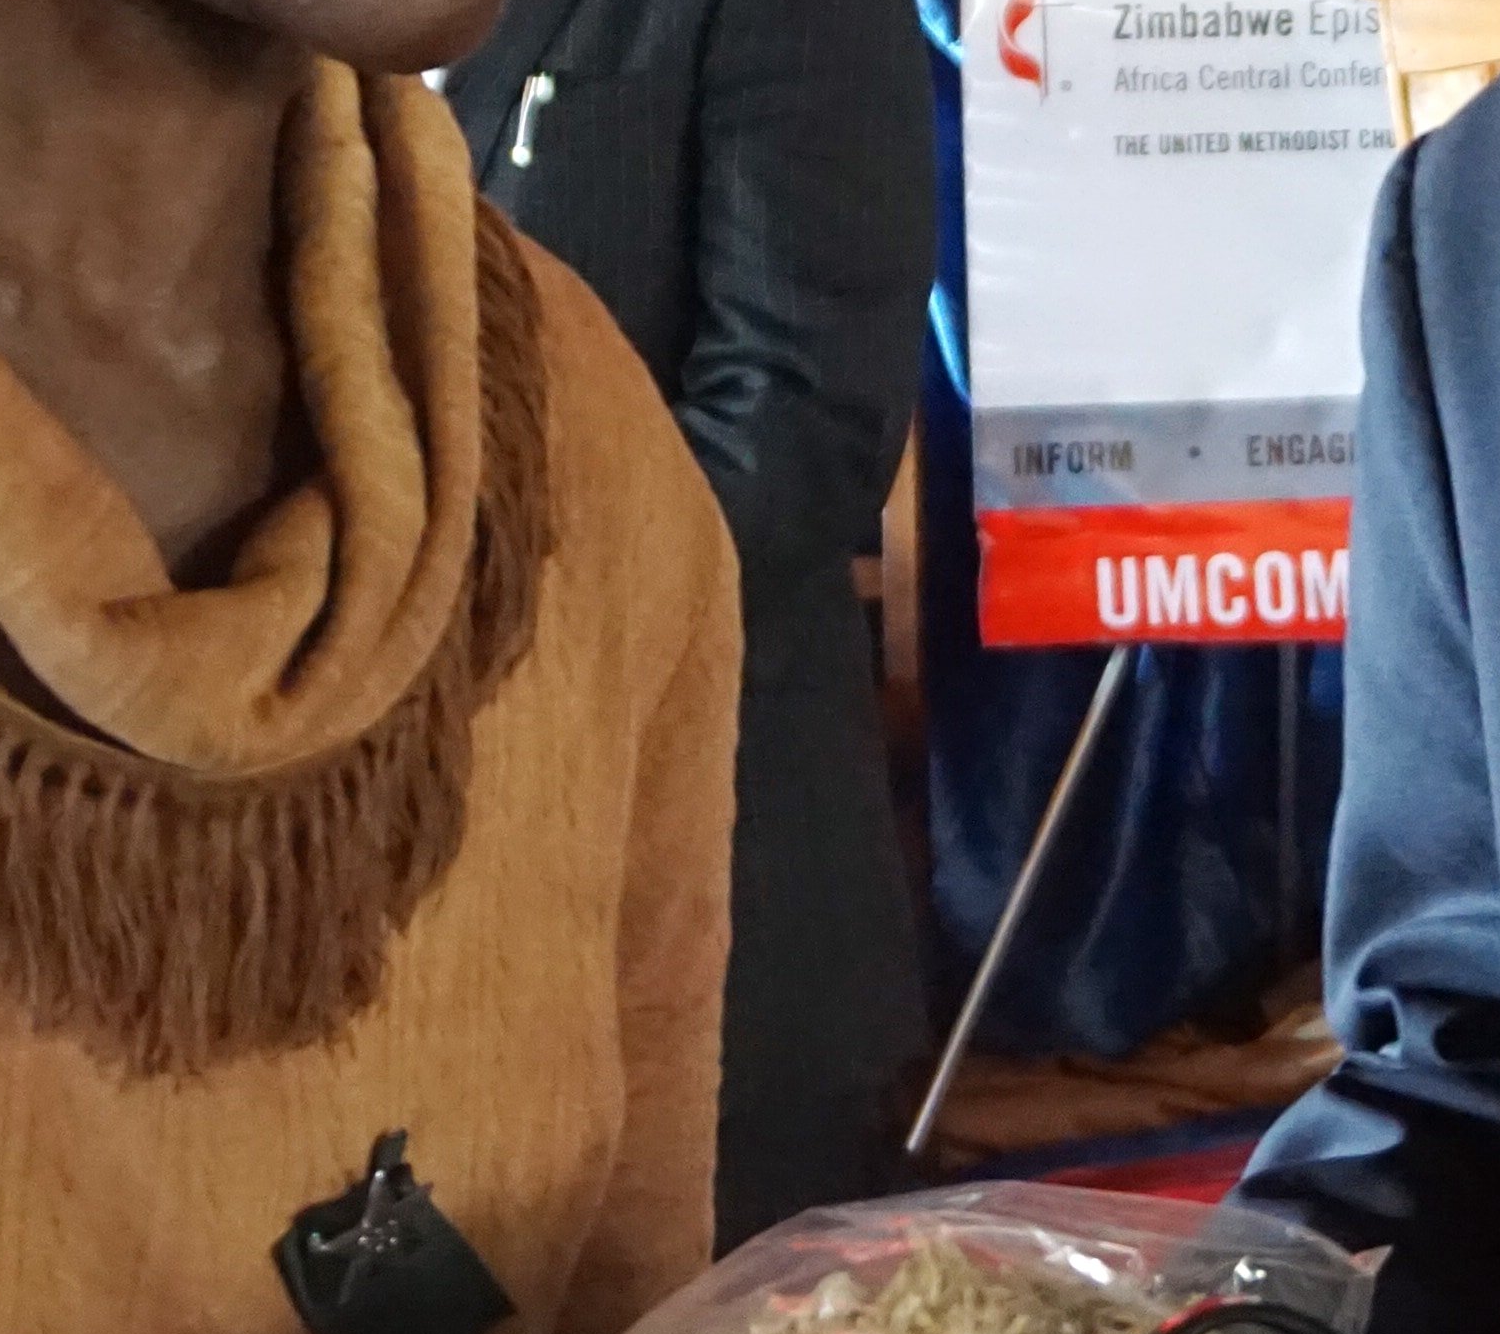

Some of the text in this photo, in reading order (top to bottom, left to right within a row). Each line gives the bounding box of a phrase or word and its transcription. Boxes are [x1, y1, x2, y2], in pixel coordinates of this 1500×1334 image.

[1112, 0, 1380, 43] Zimbabwe Epis
[1114, 63, 1188, 93] Africa
[1200, 61, 1290, 91] Central
[1113, 133, 1149, 156] THE
[1158, 131, 1230, 155] UNITED
[1238, 129, 1350, 152] METHODIST
[1013, 438, 1137, 476] INFORM
[1095, 547, 1350, 629] UMCOM
